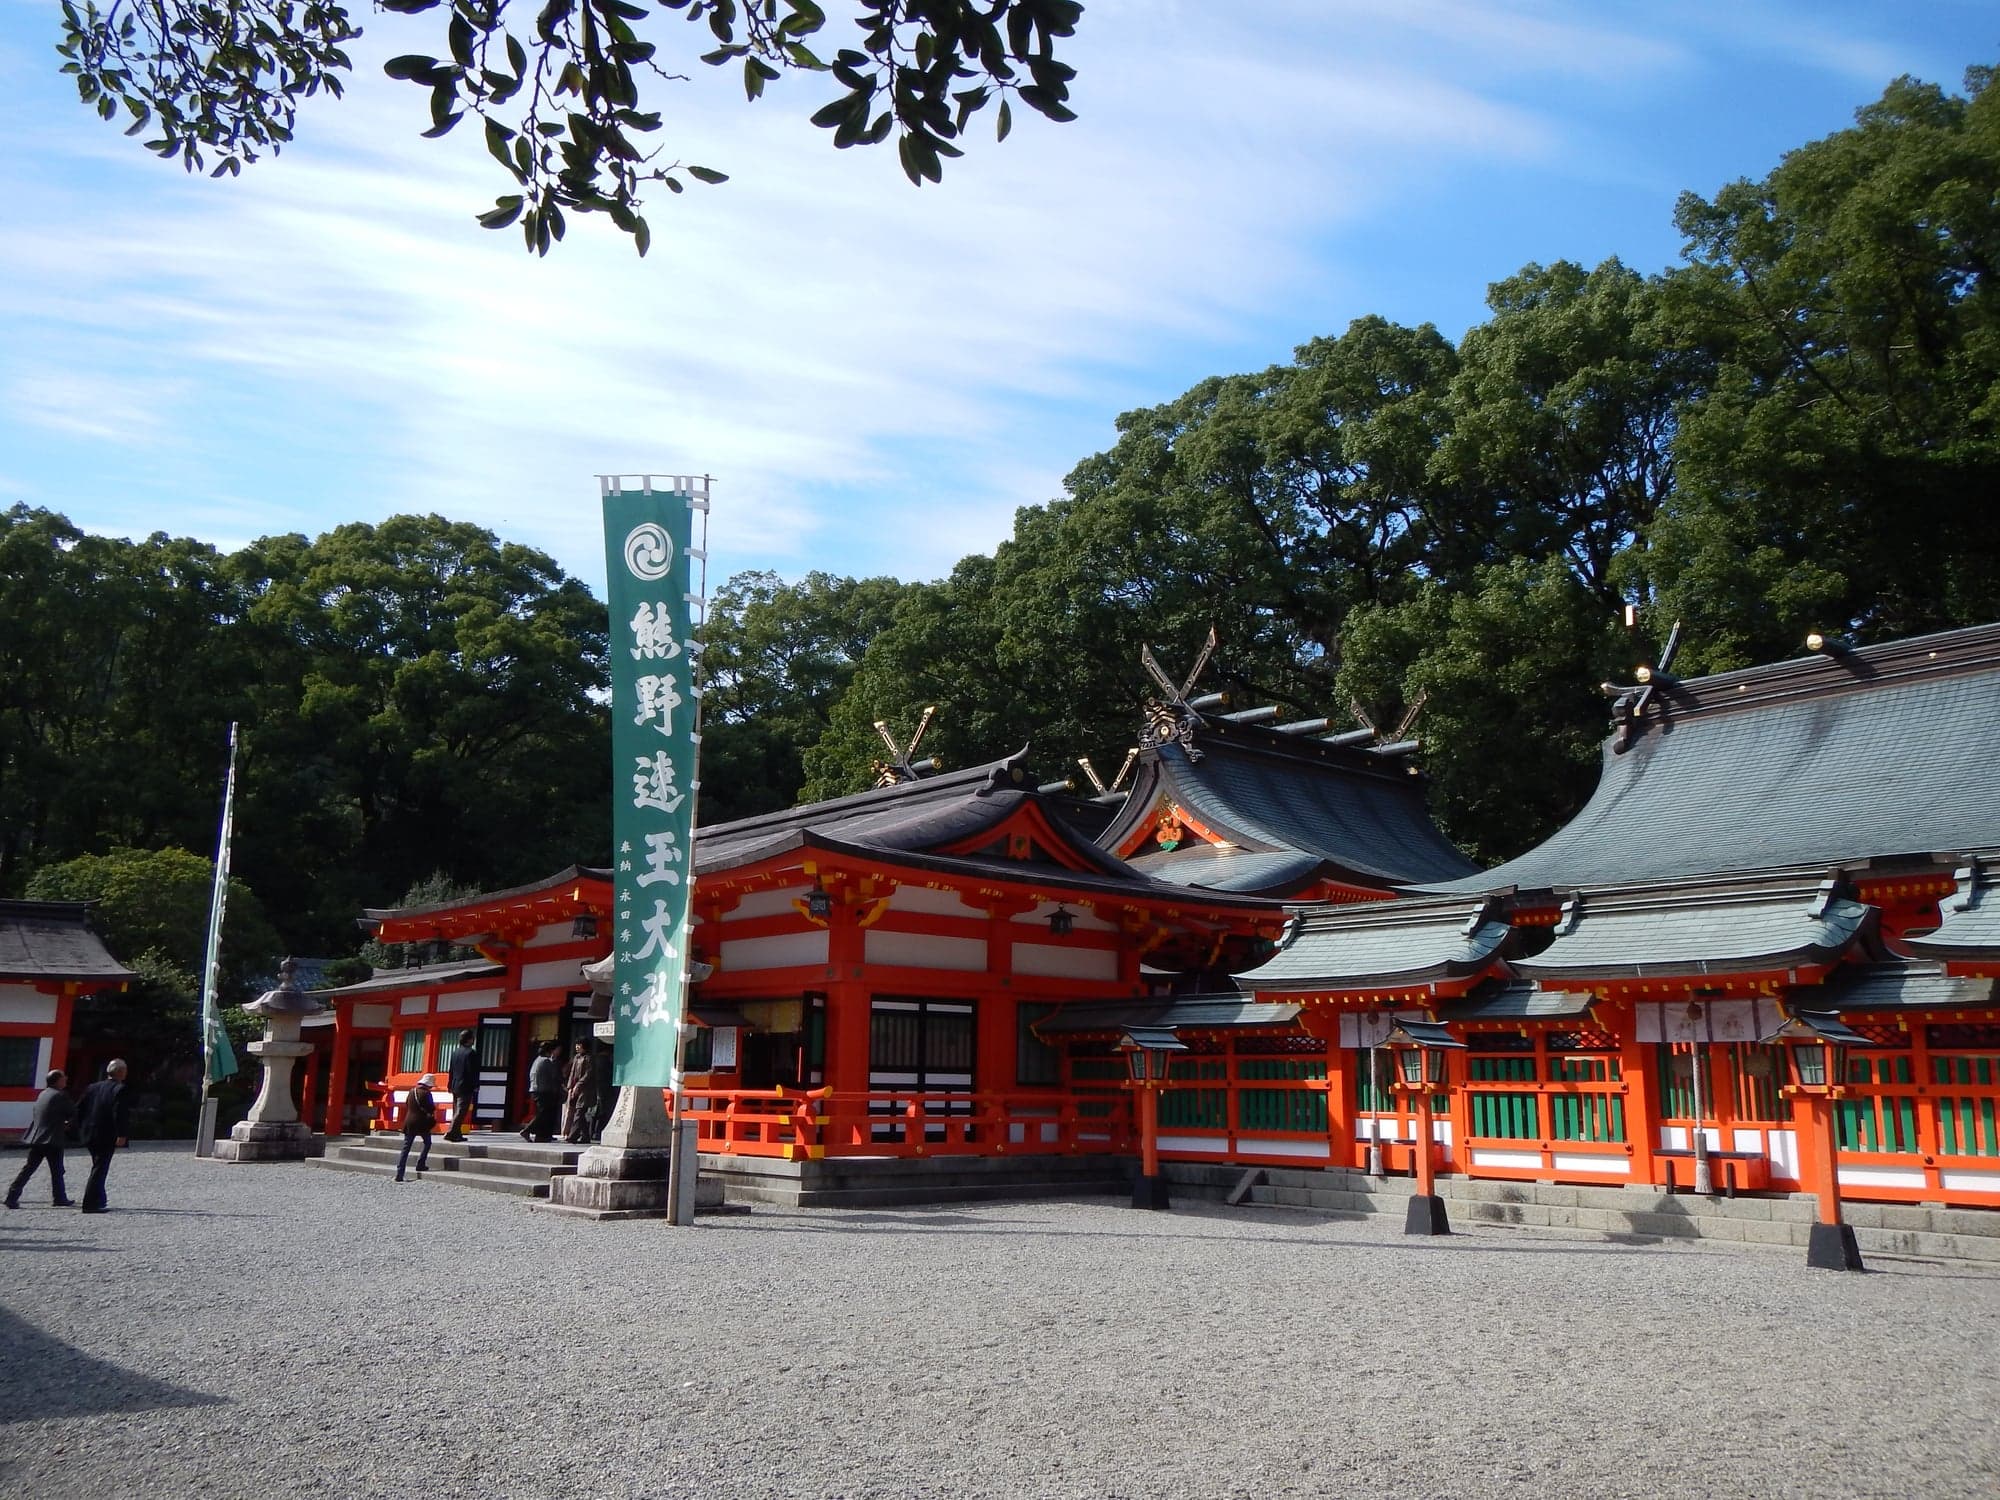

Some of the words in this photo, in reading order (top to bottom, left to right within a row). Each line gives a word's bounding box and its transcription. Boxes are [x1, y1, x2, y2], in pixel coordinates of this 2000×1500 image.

[630, 601, 685, 1027] 熊野速玉大社
[619, 840, 632, 872] 奉納
[619, 888, 632, 964] 永田秀次
